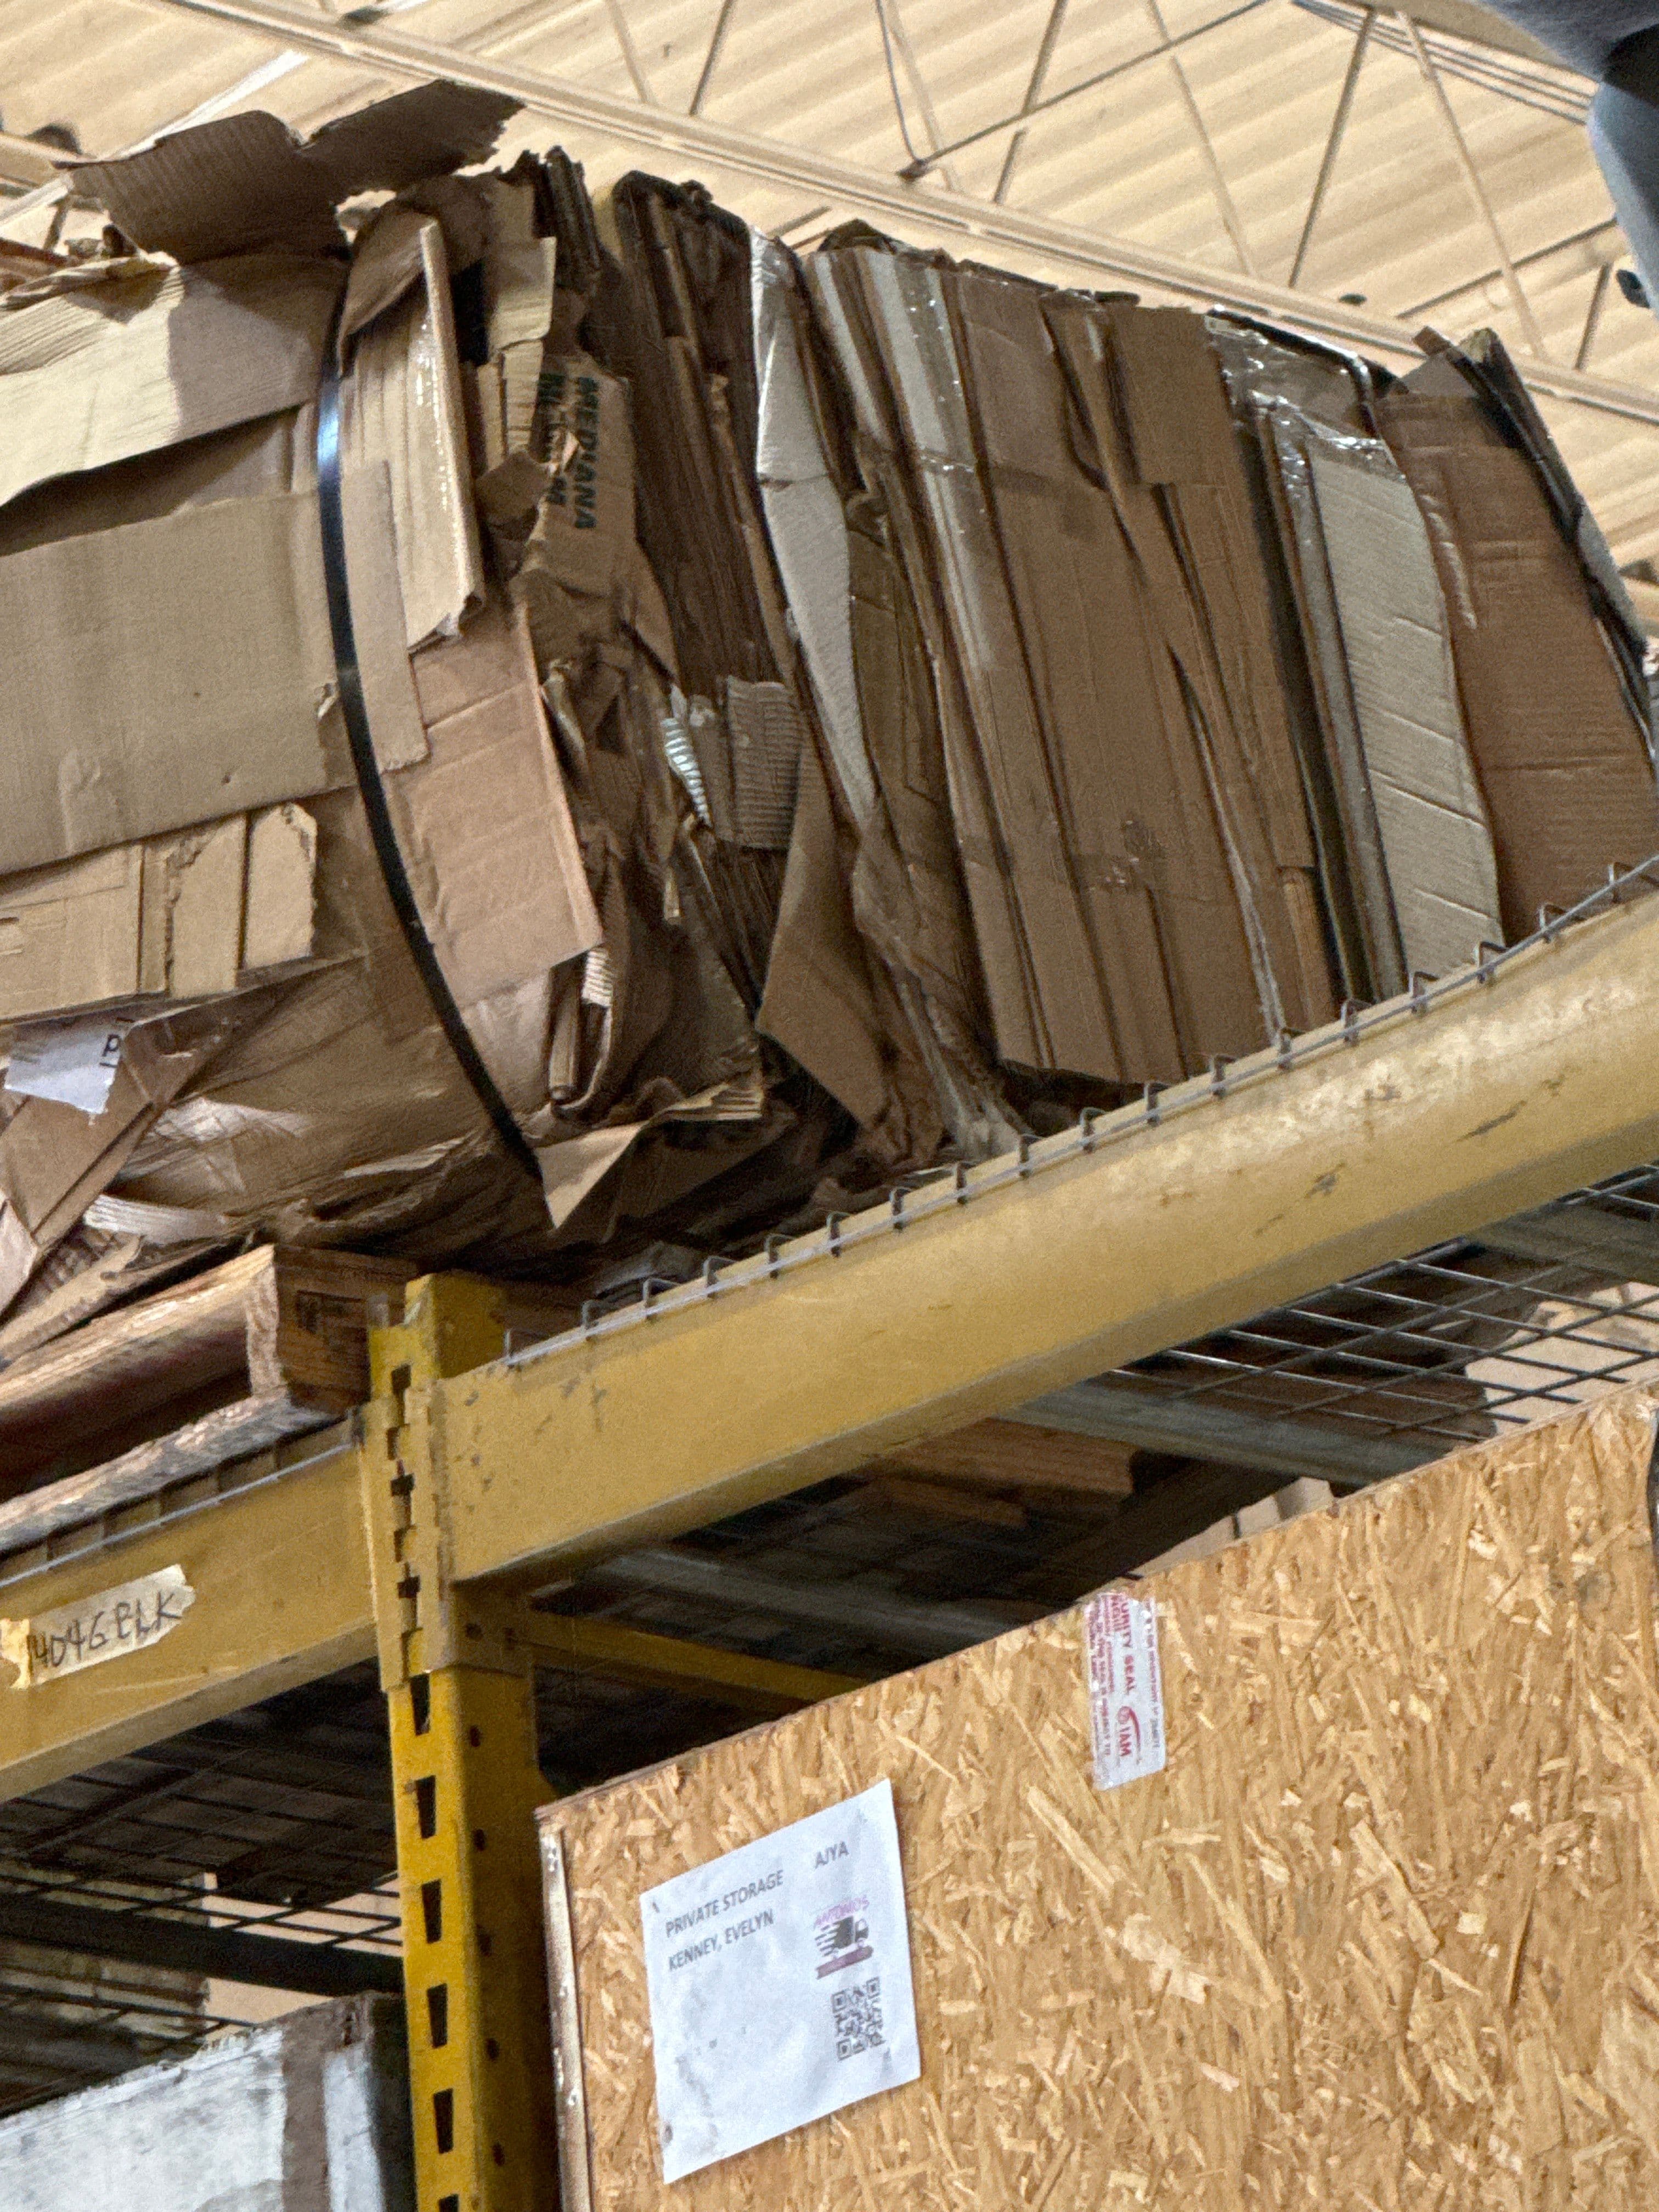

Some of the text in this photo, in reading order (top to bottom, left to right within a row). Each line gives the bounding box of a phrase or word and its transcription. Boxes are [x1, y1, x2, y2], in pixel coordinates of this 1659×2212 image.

[666, 1870, 783, 1938] PRIVATE STORAGE
[668, 1909, 774, 1972] KENNEY, EVELYN
